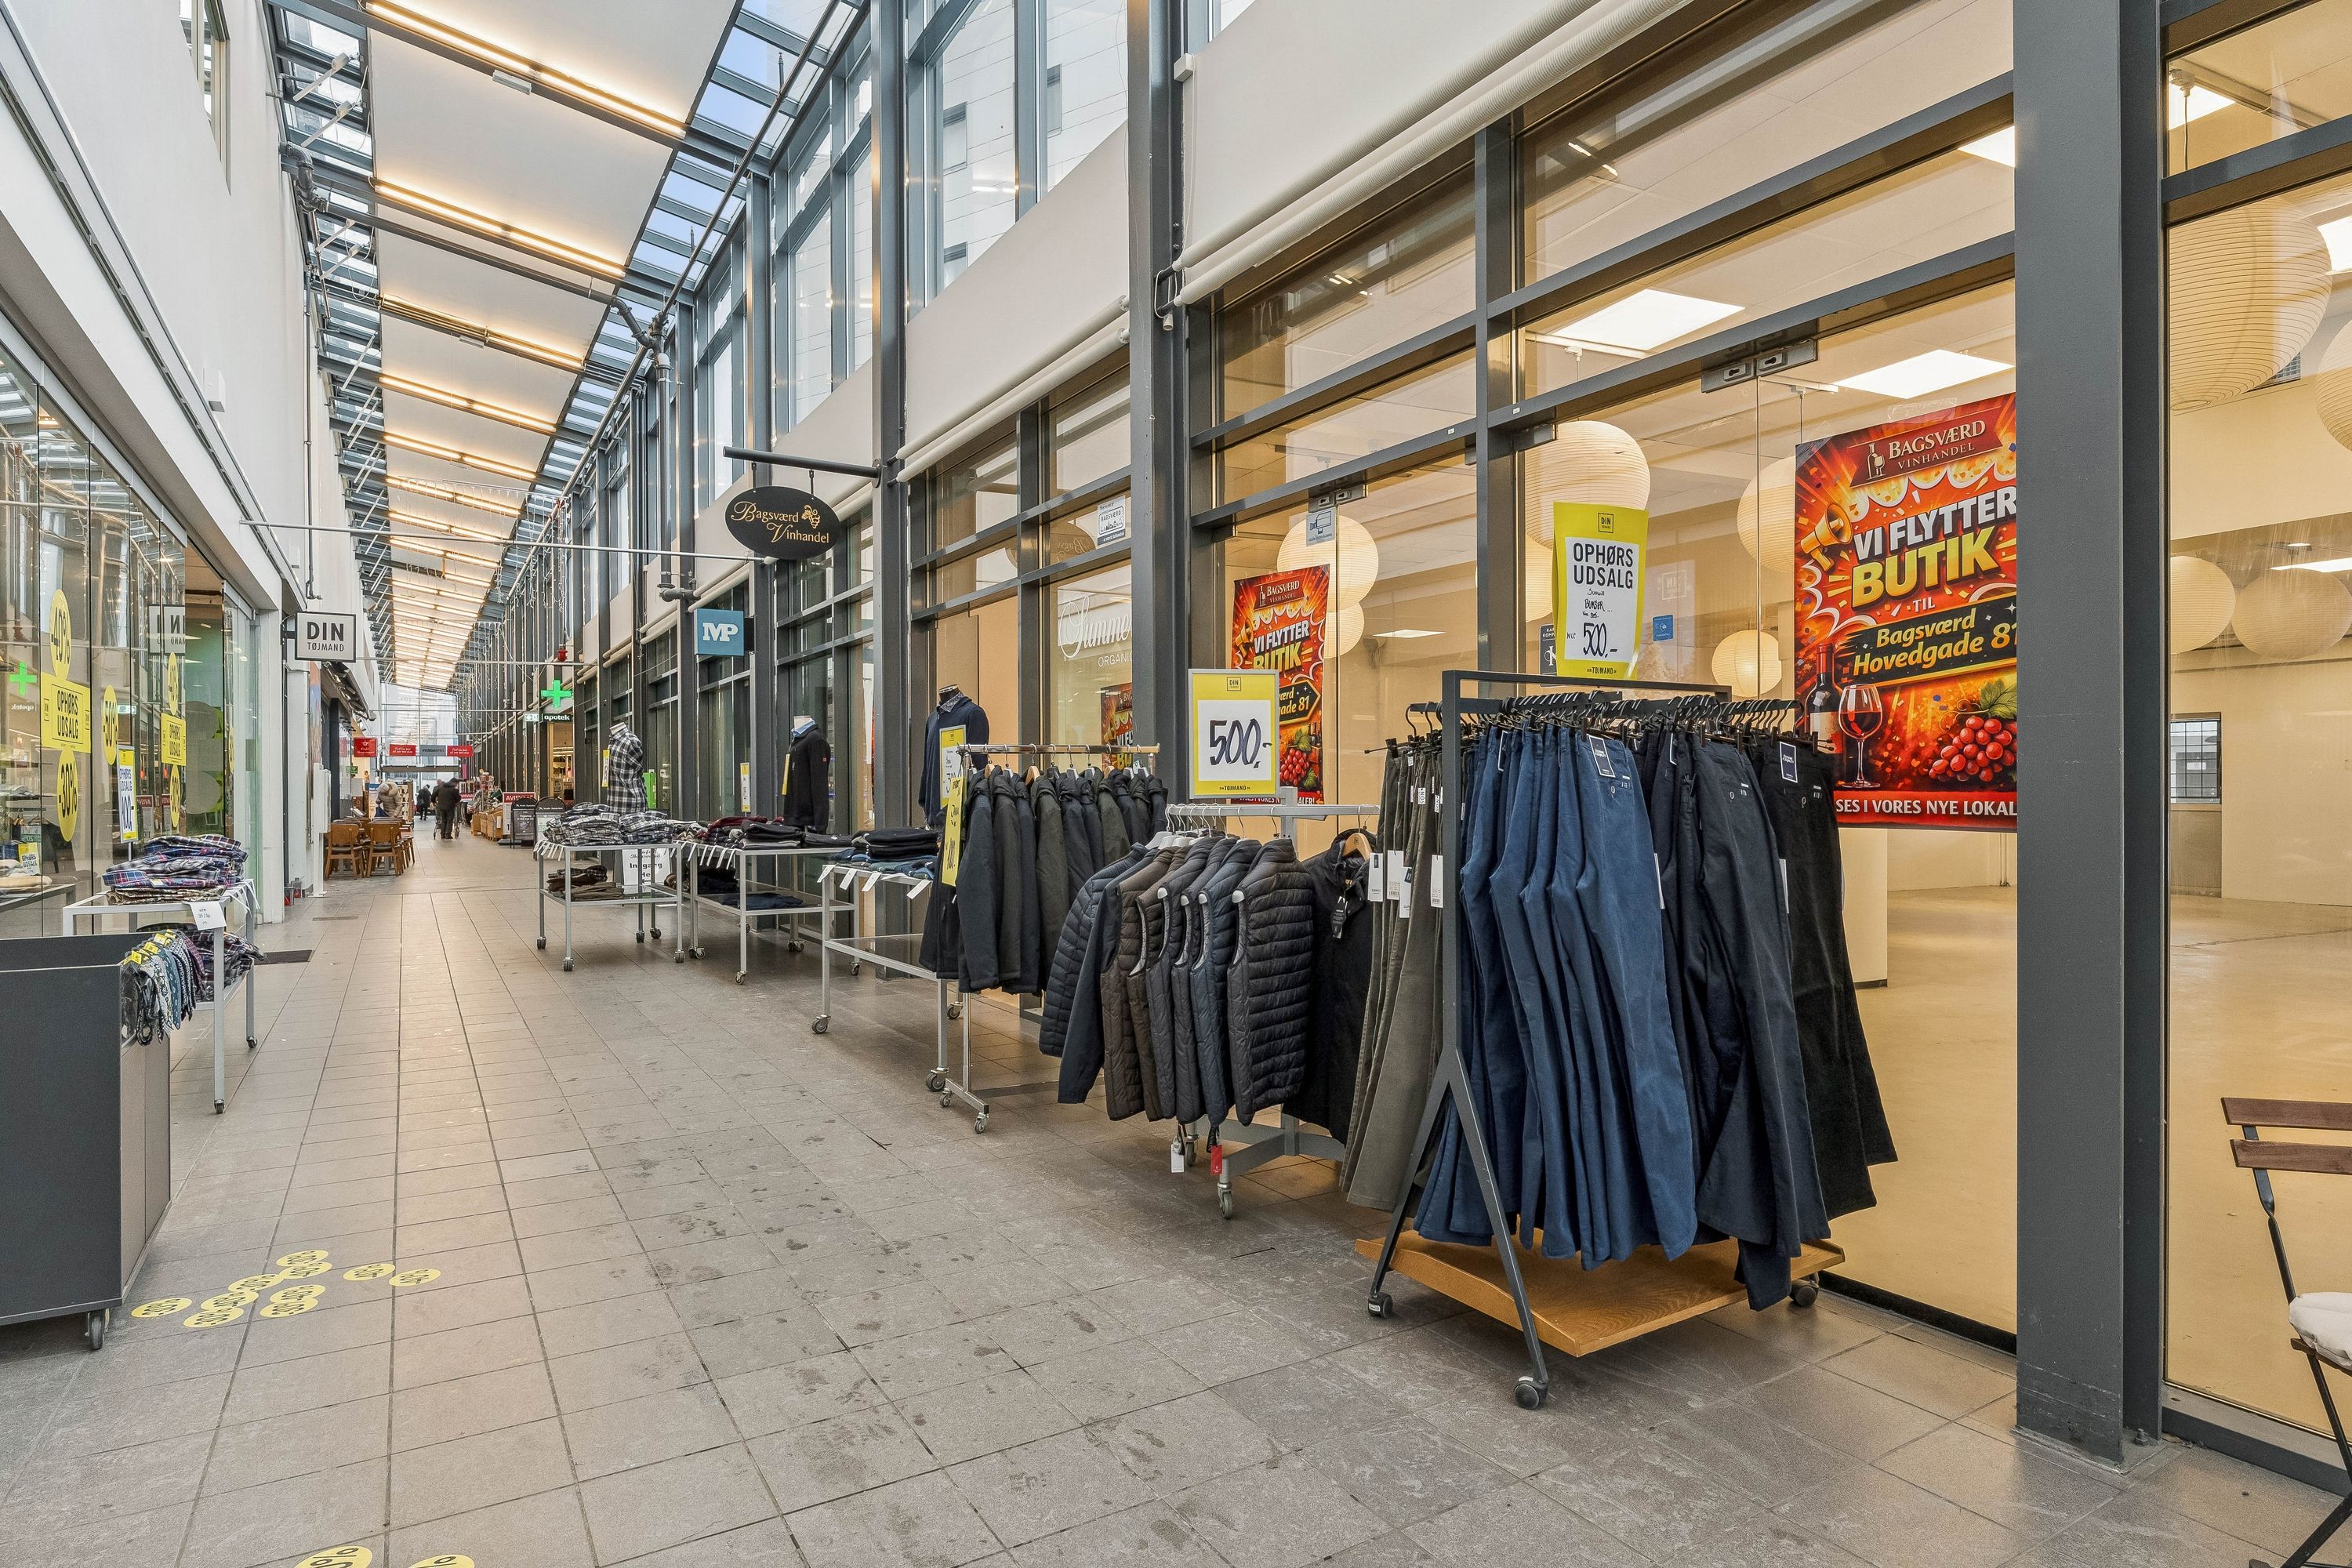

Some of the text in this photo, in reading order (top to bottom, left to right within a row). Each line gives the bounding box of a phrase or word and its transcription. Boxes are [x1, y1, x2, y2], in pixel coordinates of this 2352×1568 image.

[1889, 419, 1986, 460] BAGSVÆRD
[1897, 442, 1975, 470] VINHANDEL
[731, 501, 799, 523] Bagsværd
[1601, 517, 1611, 525] DIN
[1853, 485, 2017, 561] VI FLYTTER
[766, 522, 829, 543] Vinhandel
[1573, 543, 1634, 568] OPHØRS
[1852, 525, 1999, 608] BUTIK
[1267, 580, 1300, 597] BAGSVÆRD
[1573, 564, 1634, 589] UDSALG
[1912, 597, 1936, 613] TIL
[51, 607, 71, 665] -40%
[307, 622, 344, 641] DIN
[702, 622, 739, 642] MP
[1254, 620, 1310, 654] VI FLYTTER
[1876, 608, 1976, 648] Bagsværd
[307, 642, 344, 652] TØJMAND
[1853, 631, 1985, 677] Hovedgade
[57, 689, 78, 716] OPHØRS
[1298, 695, 1310, 710] 81
[57, 714, 79, 739] UDSALG
[1210, 718, 1273, 769] 500,-
[59, 762, 78, 818] -30%
[1835, 798, 1860, 813] SES
[1864, 799, 1868, 813] I
[1872, 800, 1922, 815] VORES
[1926, 800, 1958, 815] NYE
